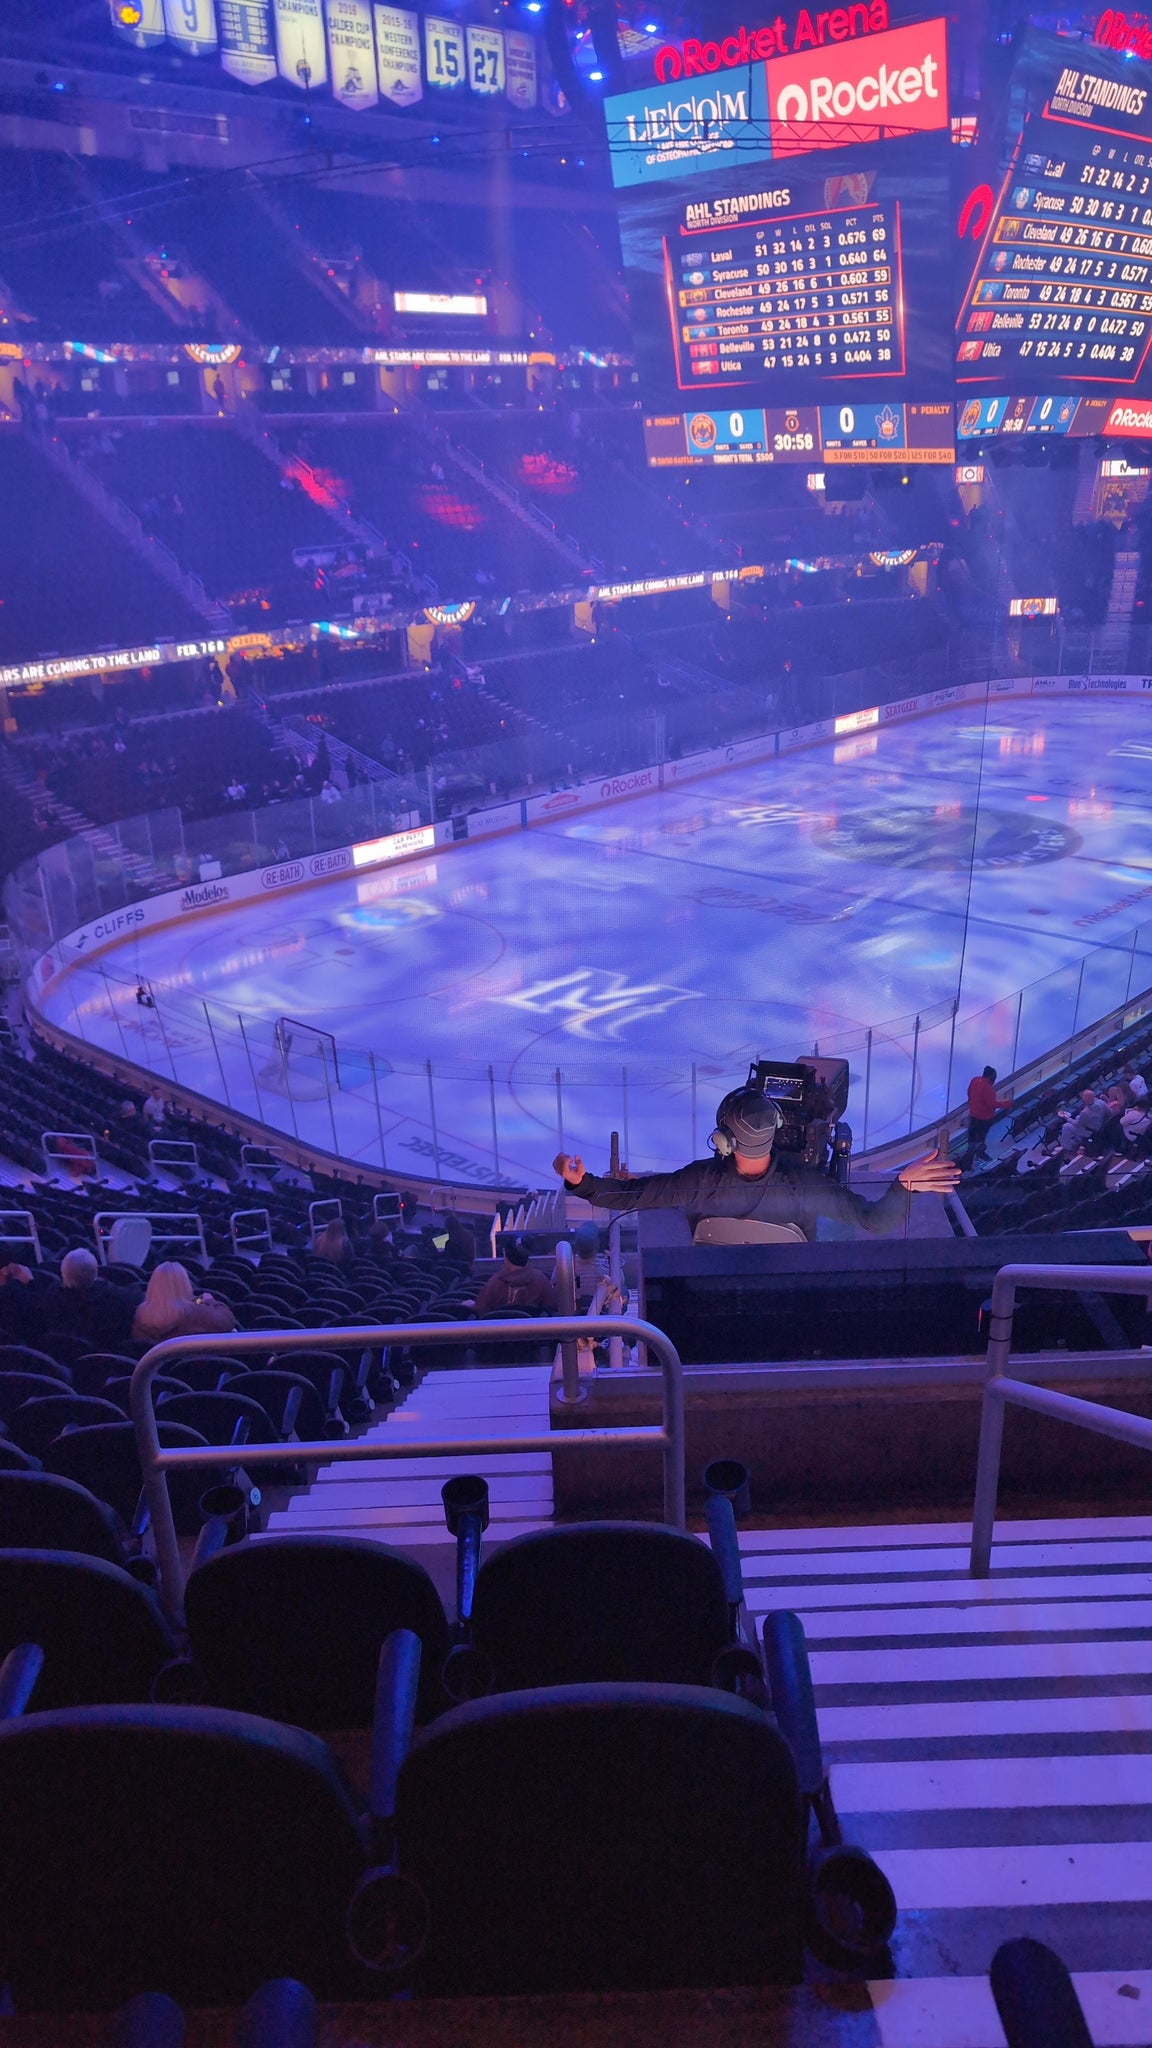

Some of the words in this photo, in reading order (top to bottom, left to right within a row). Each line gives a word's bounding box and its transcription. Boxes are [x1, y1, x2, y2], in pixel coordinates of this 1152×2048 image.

[384, 31, 412, 45] WESTERN
[684, 15, 789, 77] Rocket
[793, 0, 888, 50] Arena
[380, 44, 418, 61] CONFERENCE
[434, 39, 458, 77] 15
[474, 47, 498, 85] 27
[811, 53, 939, 121] Rocket
[1056, 68, 1080, 98] AHL
[1076, 74, 1148, 116] STANDINGS
[1080, 165, 1095, 183] 51
[1096, 168, 1110, 186] 32
[1112, 172, 1124, 189] 14
[686, 200, 712, 221] AHL
[714, 189, 790, 216] STANDINGS
[1033, 192, 1065, 212] Syracuse
[687, 217, 709, 229] NORTH
[710, 214, 738, 226] DIVISION
[1023, 223, 1058, 242] Cleveland
[711, 251, 732, 263] Laval
[755, 244, 768, 257] 51
[773, 242, 786, 254] 32
[790, 240, 802, 252] 14
[808, 238, 815, 249] 2
[823, 236, 830, 248] 3
[838, 231, 866, 245] 0.676
[872, 228, 885, 241] 69
[713, 268, 749, 282] Syracuse
[756, 263, 769, 276] 50
[774, 261, 787, 274] 30
[792, 260, 803, 271] 16
[809, 258, 816, 269] 3
[826, 256, 831, 267] 1
[839, 251, 867, 265] 0.640
[873, 249, 886, 261] 64
[1012, 254, 1046, 271] Rochester
[715, 286, 752, 299] Cleveland
[758, 283, 771, 295] 49
[776, 281, 788, 293] 26
[793, 279, 804, 291] 16
[810, 277, 817, 289] 6
[827, 276, 832, 287] 1
[841, 272, 868, 286] 0.602
[874, 270, 887, 282] 59
[1002, 284, 1030, 300] Toronto
[716, 304, 753, 317] Rochester
[760, 301, 772, 314] 49
[777, 300, 790, 311] 24
[794, 298, 806, 310] 17
[811, 297, 818, 308] 5
[827, 295, 834, 306] 3
[842, 291, 869, 305] 0.571
[875, 289, 888, 301] 56
[718, 324, 748, 336] Toronto
[761, 320, 773, 332] 49
[778, 319, 791, 330] 24
[796, 317, 807, 329] 18
[813, 316, 820, 327] 4
[828, 314, 835, 326] 3
[843, 310, 869, 324] 0.561
[876, 309, 889, 321] 55
[992, 314, 1024, 329] Belleville
[1028, 313, 1042, 329] 53
[1043, 314, 1057, 330] 21
[1058, 315, 1071, 330] 24
[1100, 318, 1127, 336] 0.472
[1129, 322, 1145, 336] 50
[719, 341, 755, 354] Belleville
[762, 339, 775, 350] 53
[780, 338, 791, 349] 21
[796, 336, 808, 347] 24
[814, 335, 821, 346] 8
[829, 333, 836, 345] 0
[844, 330, 871, 344] 0.472
[877, 329, 890, 341] 50
[982, 342, 1002, 358] Utica
[1019, 341, 1033, 356] 47
[1036, 342, 1048, 357] 15
[1048, 342, 1062, 357] 24
[1090, 344, 1117, 360] 0.404
[1120, 346, 1134, 362] 38
[721, 360, 741, 371] Utica
[764, 357, 776, 368] 47
[782, 356, 793, 367] 15
[797, 355, 810, 366] 24
[815, 353, 822, 365] 5
[830, 352, 837, 364] 3
[844, 350, 872, 363] 0.404
[878, 349, 891, 360] 38
[840, 406, 854, 434] 0
[920, 406, 950, 414] PENALTY
[986, 400, 998, 422] 0
[1040, 398, 1053, 420] 0
[730, 412, 744, 437] 0
[1003, 418, 1024, 432] 30:58
[774, 434, 814, 450] 30:58
[853, 451, 865, 460] $10
[893, 451, 906, 460] $20
[911, 451, 922, 459] 125
[924, 451, 937, 459] FOR
[938, 452, 952, 460] $40
[612, 586, 632, 596] STARS
[632, 584, 644, 592] ARE
[644, 580, 668, 590] COMING
[668, 580, 676, 588] TO
[676, 577, 688, 586] THE
[688, 574, 704, 584] LAND
[21, 664, 44, 679] ARE
[46, 659, 89, 676] COMING
[90, 657, 106, 669] TO
[108, 654, 130, 667] THE
[131, 650, 160, 664] LAND
[1088, 678, 1127, 690] Technologies
[885, 700, 918, 719] SEATGEEK
[612, 771, 652, 794] Rocket
[314, 852, 347, 874] RE-BATH
[266, 864, 300, 886] RE-BATH
[184, 884, 224, 907] Modelo
[94, 908, 145, 939] CLIFFS
